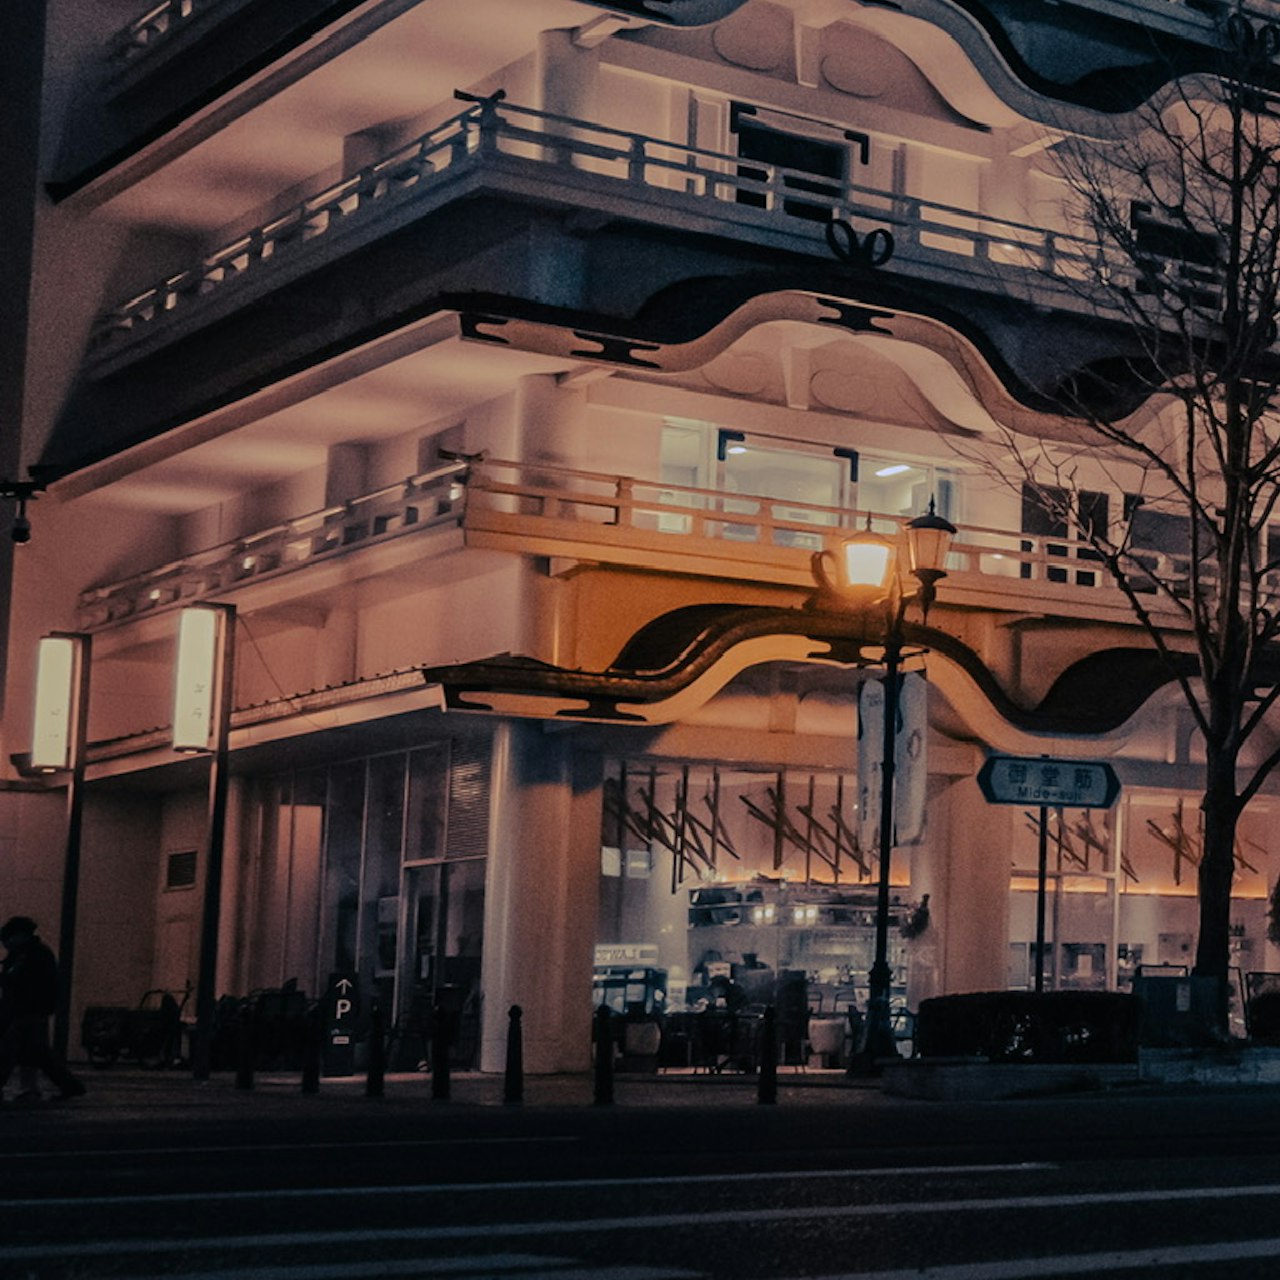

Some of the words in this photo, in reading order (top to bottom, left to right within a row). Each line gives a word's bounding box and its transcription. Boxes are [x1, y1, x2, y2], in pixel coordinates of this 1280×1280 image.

[1007, 763, 1093, 790] 御堂筋
[336, 999, 352, 1019] P
